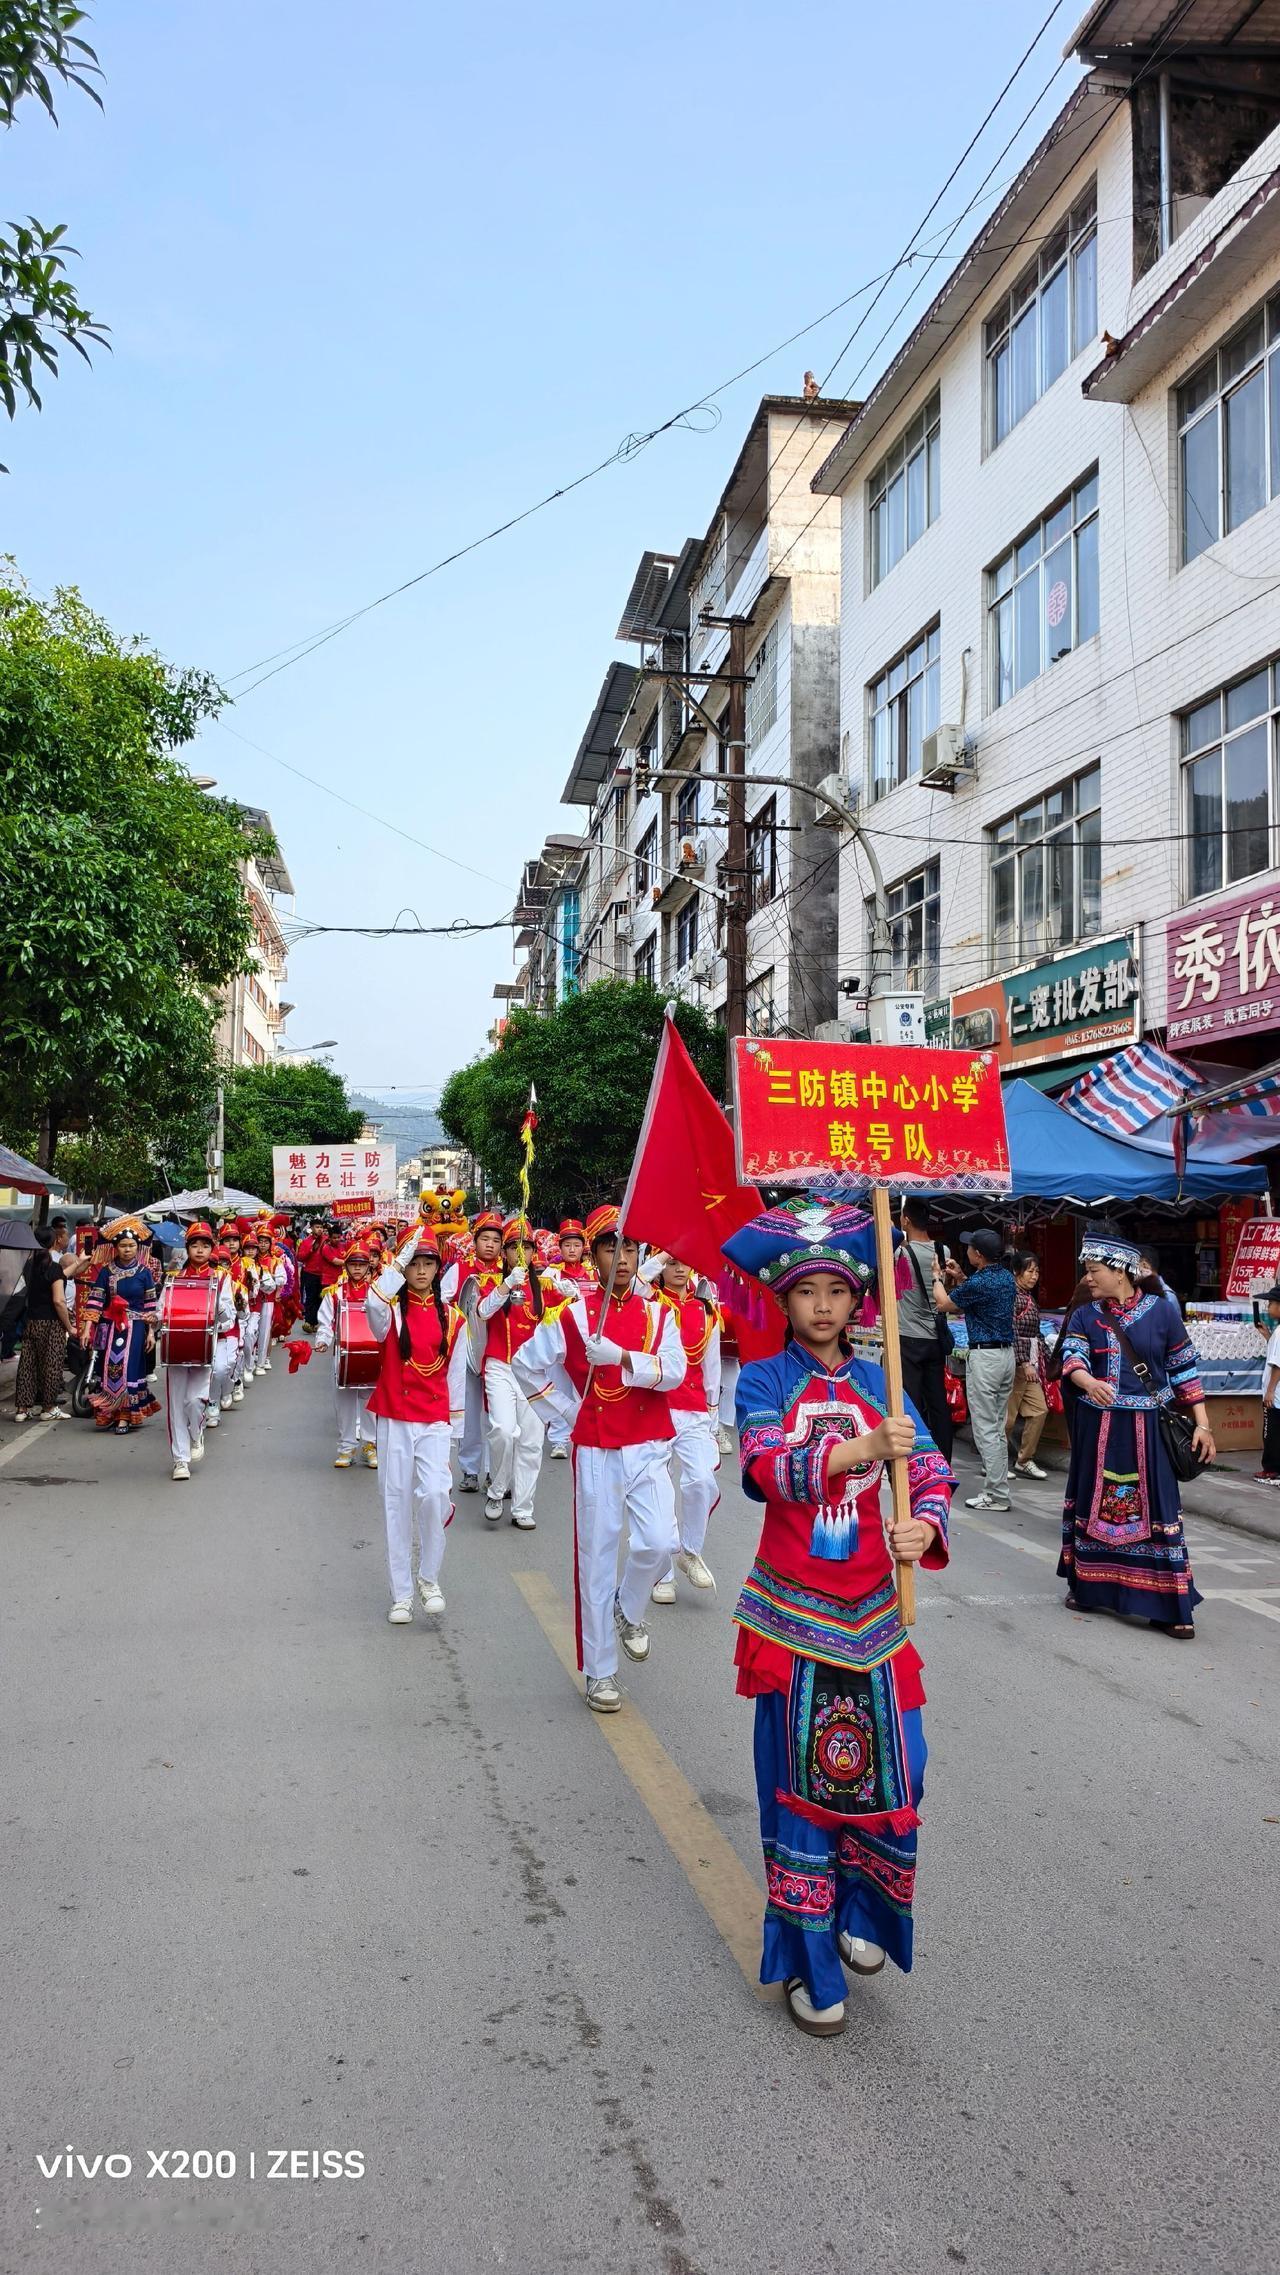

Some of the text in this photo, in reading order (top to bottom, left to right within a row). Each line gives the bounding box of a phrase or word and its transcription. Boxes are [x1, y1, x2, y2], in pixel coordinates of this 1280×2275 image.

[1005, 958, 1130, 1038] 仁宽批发部
[1223, 1000, 1274, 1026] 微信同号
[768, 1068, 979, 1114] 三防镇中心小学
[828, 1120, 933, 1161] 鼓号队
[289, 1151, 381, 1169] 魅力三防
[290, 1171, 380, 1188] 红色壮乡
[1235, 1265, 1254, 1277] 15元
